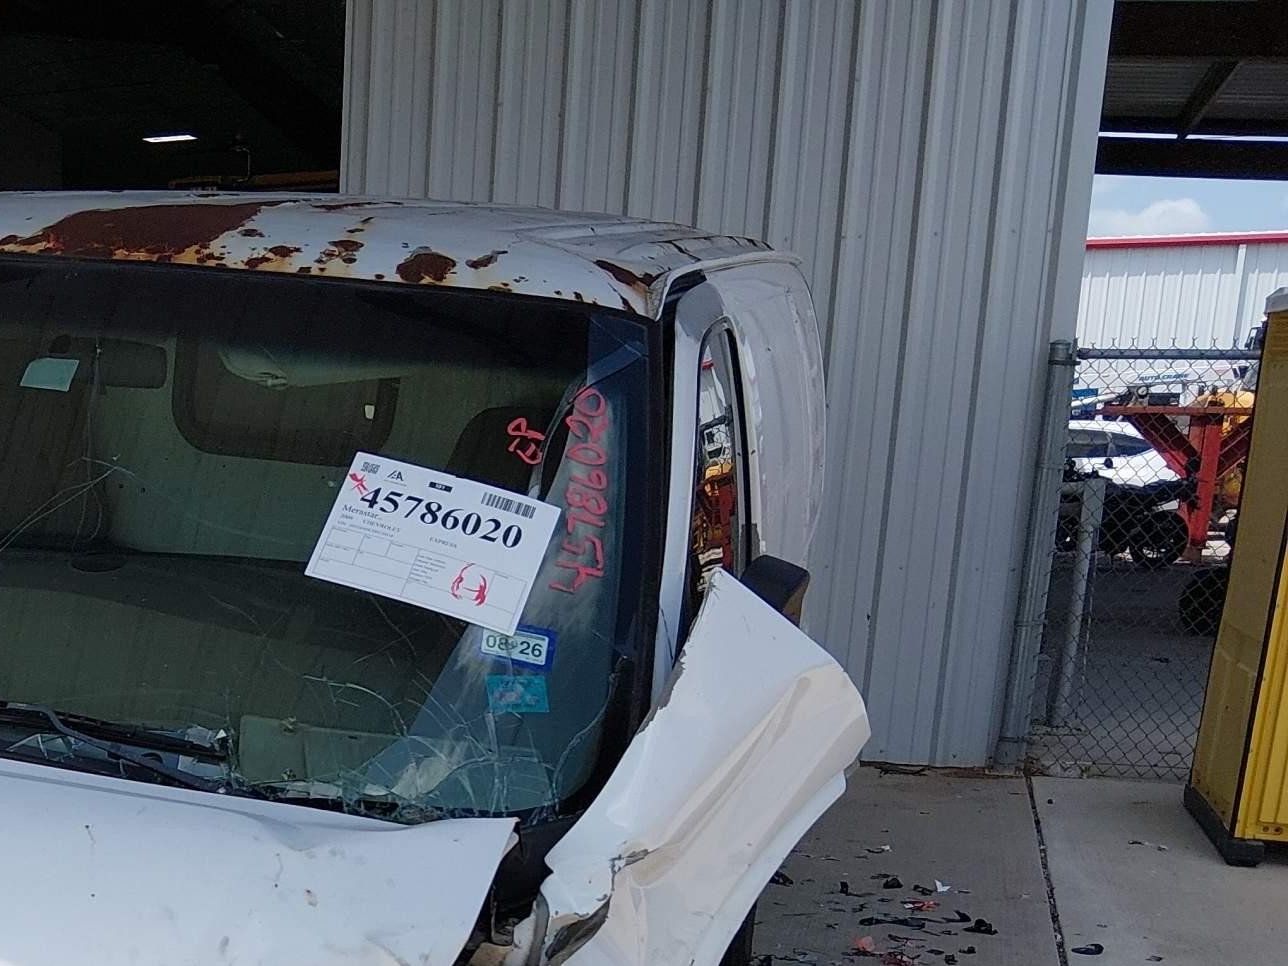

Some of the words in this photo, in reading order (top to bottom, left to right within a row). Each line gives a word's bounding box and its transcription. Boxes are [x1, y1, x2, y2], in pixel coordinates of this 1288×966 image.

[359, 487, 523, 549] 45786020
[550, 387, 608, 592] 45786020
[518, 640, 544, 658] 26
